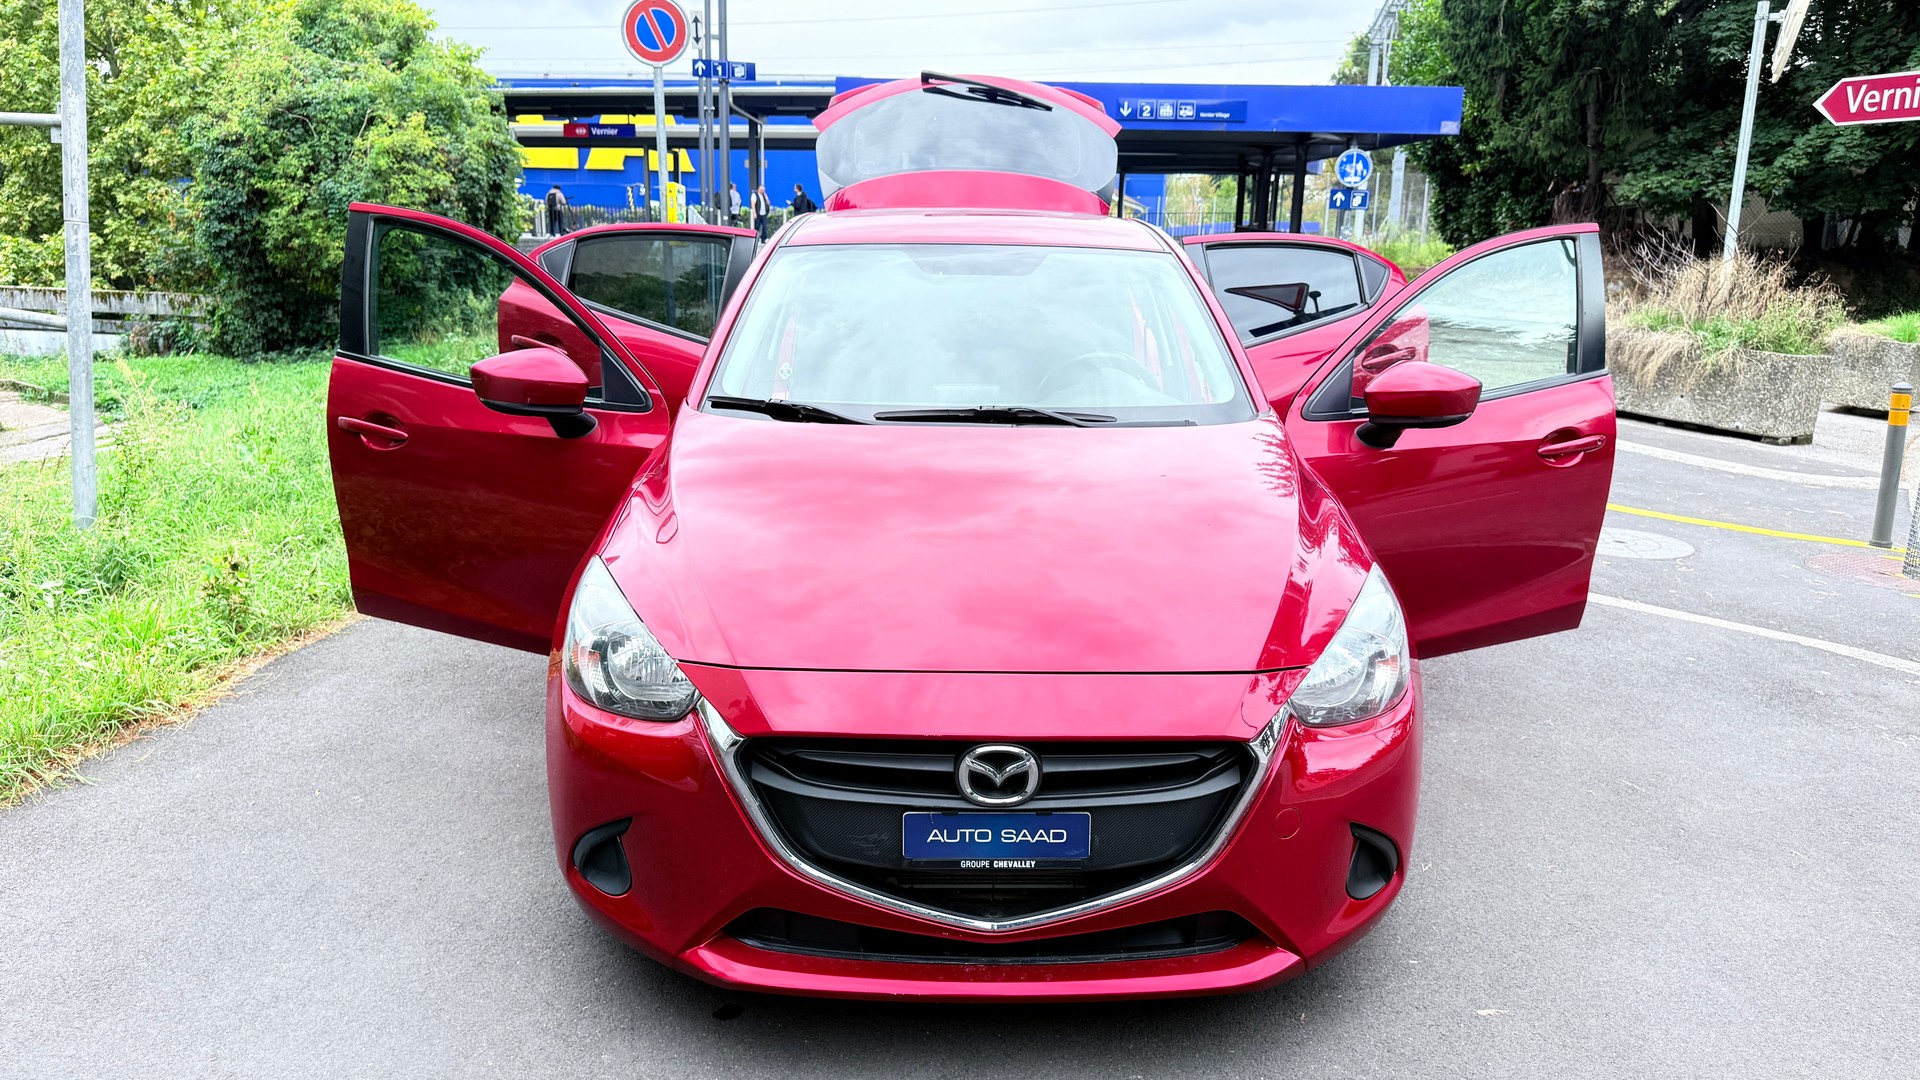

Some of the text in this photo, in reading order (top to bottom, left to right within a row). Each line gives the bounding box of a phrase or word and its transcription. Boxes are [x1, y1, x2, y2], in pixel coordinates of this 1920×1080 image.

[716, 65, 722, 76] 1
[1142, 105, 1151, 117] 2
[590, 126, 619, 136] Vernier
[926, 829, 1067, 843] AUTO SAAD
[960, 860, 1036, 869] GROUPE CHEVALLEY
